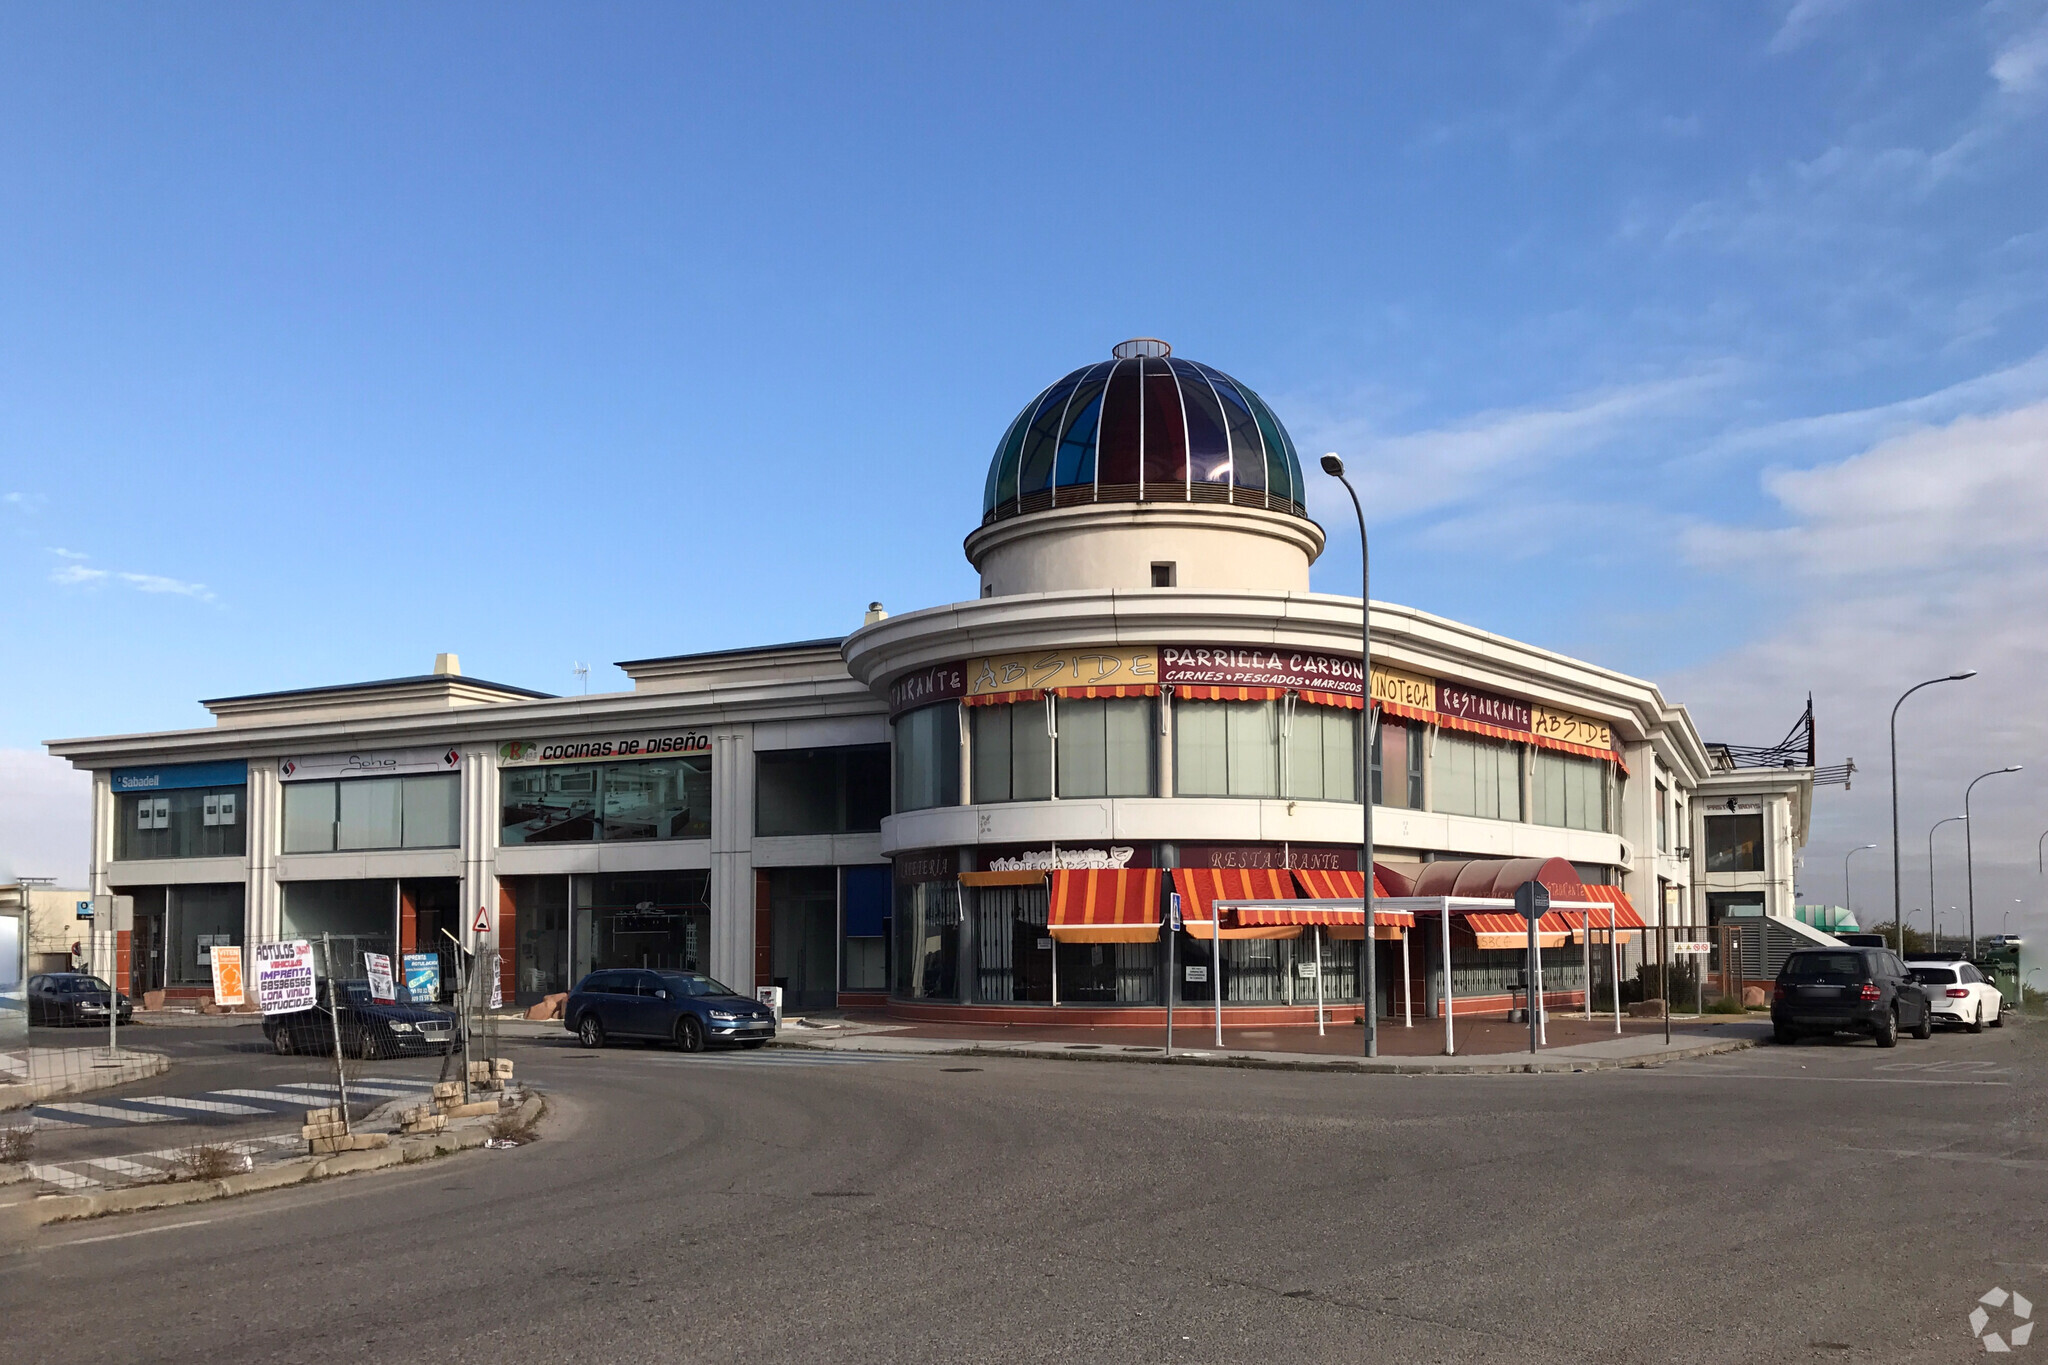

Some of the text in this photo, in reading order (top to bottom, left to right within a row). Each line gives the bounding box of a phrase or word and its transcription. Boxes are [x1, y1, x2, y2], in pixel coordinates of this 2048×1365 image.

[974, 652, 1155, 693] ABSIDE
[1164, 648, 1363, 680] PARRILLA CARBON
[1165, 670, 1363, 693] CARNES PESCADOS MARISCOS
[1443, 687, 1528, 725] RESTAURANTE
[1536, 707, 1610, 743] ABSIDE
[122, 775, 159, 788] Sabadell
[1211, 850, 1340, 869] RESTAURANTE
[260, 967, 312, 980] IMPRENTA
[261, 977, 312, 992] 685966566
[261, 987, 310, 1002] LONA VINILO
